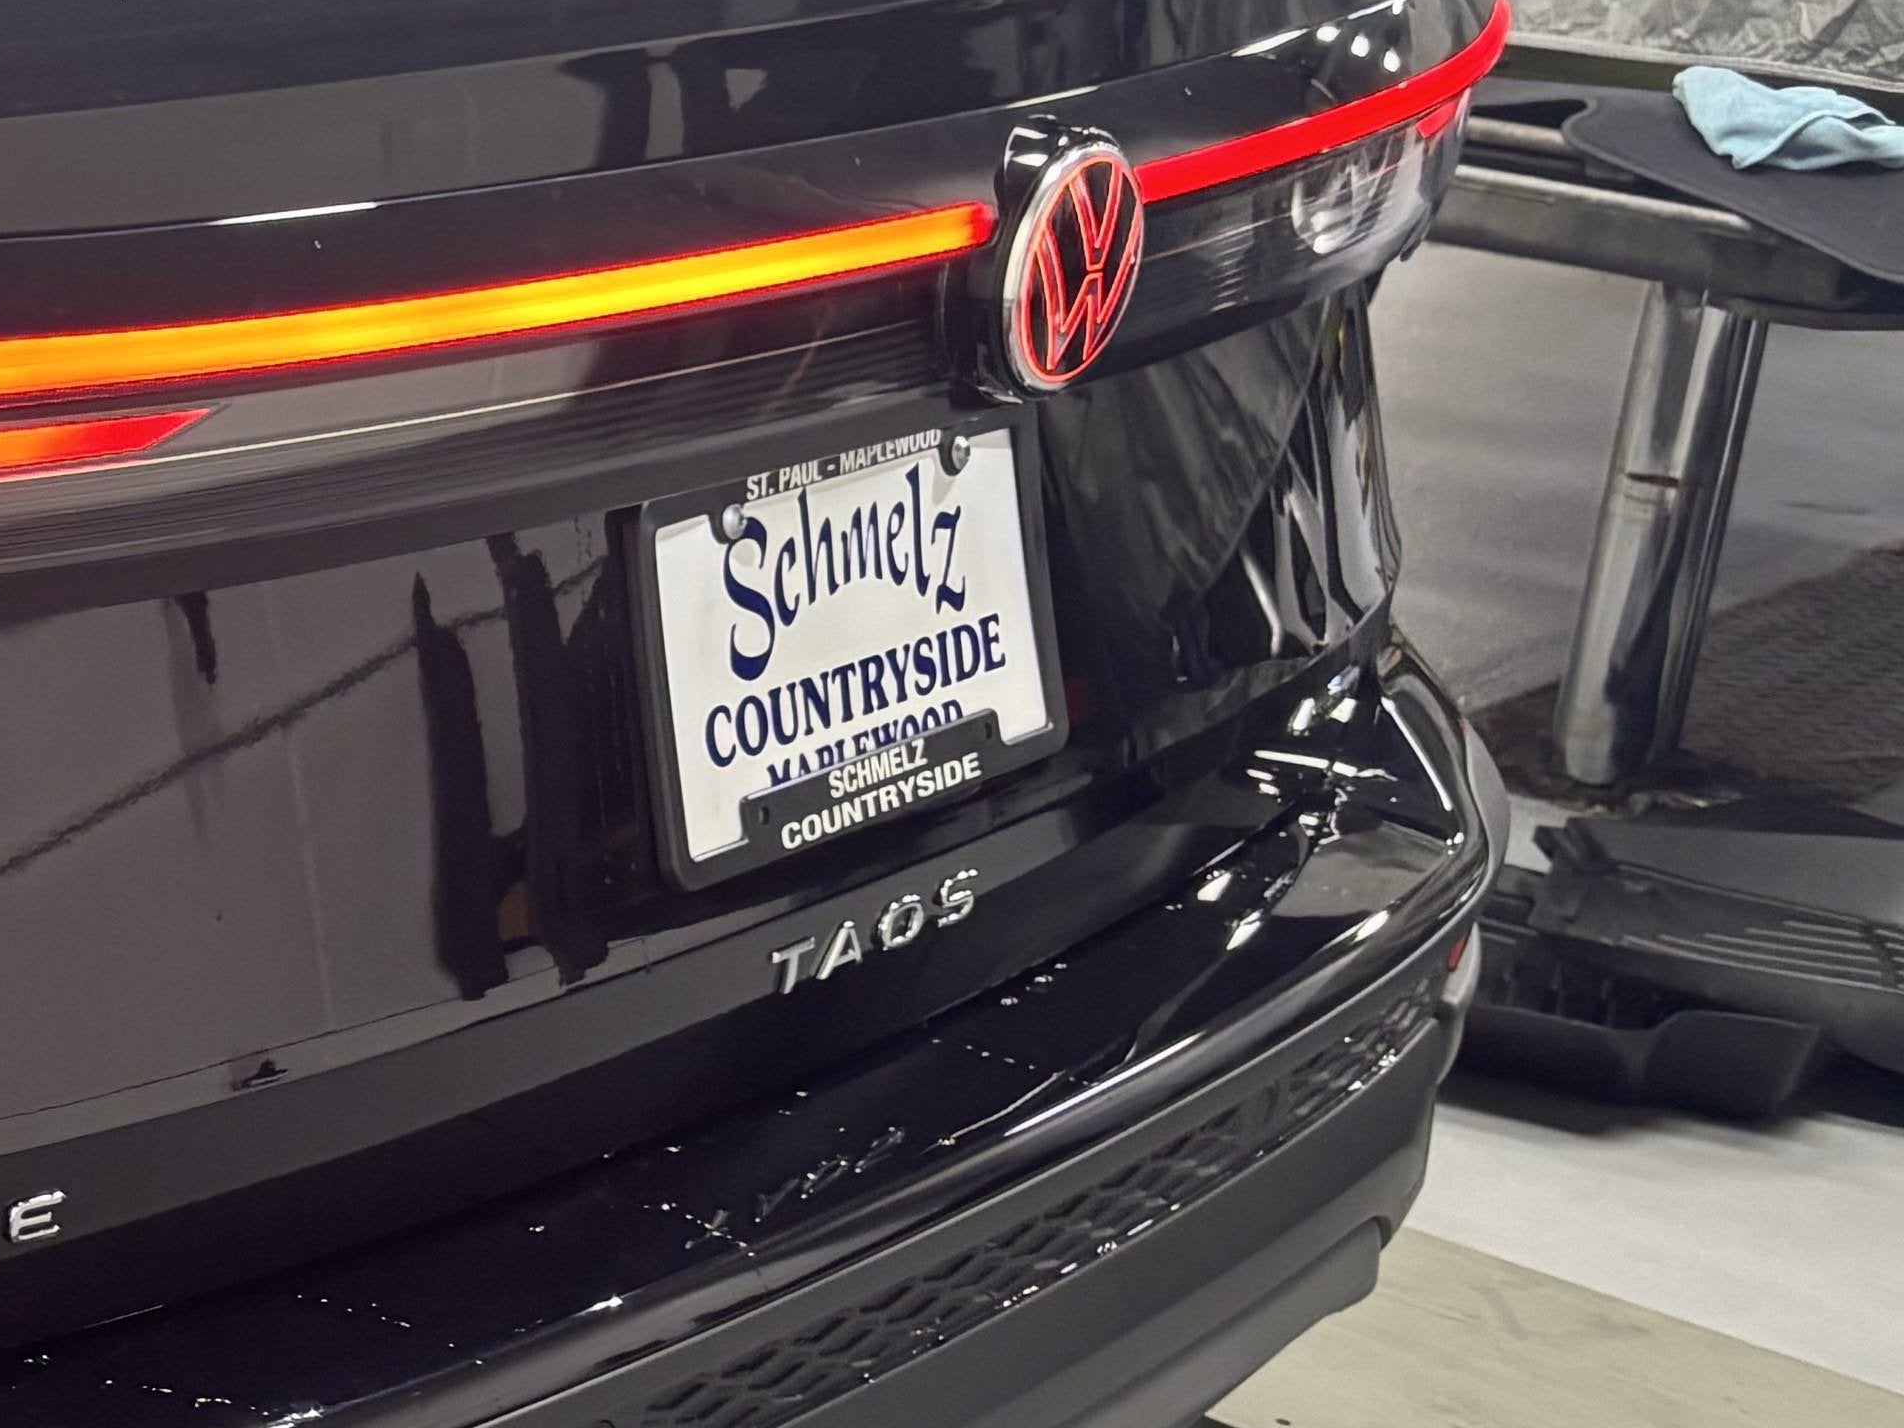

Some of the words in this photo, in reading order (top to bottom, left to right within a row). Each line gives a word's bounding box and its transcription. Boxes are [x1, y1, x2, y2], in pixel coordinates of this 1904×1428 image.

[746, 472, 776, 501] ST.
[779, 459, 823, 493] PAUL
[839, 428, 942, 474] MAPLEWOOD
[723, 462, 966, 681] Schmelz
[705, 615, 1006, 768] COUNTRYSIDE
[781, 752, 982, 850] COUNTRYSIDE
[828, 737, 928, 799] SCHMELZ
[771, 868, 979, 994] TAOS
